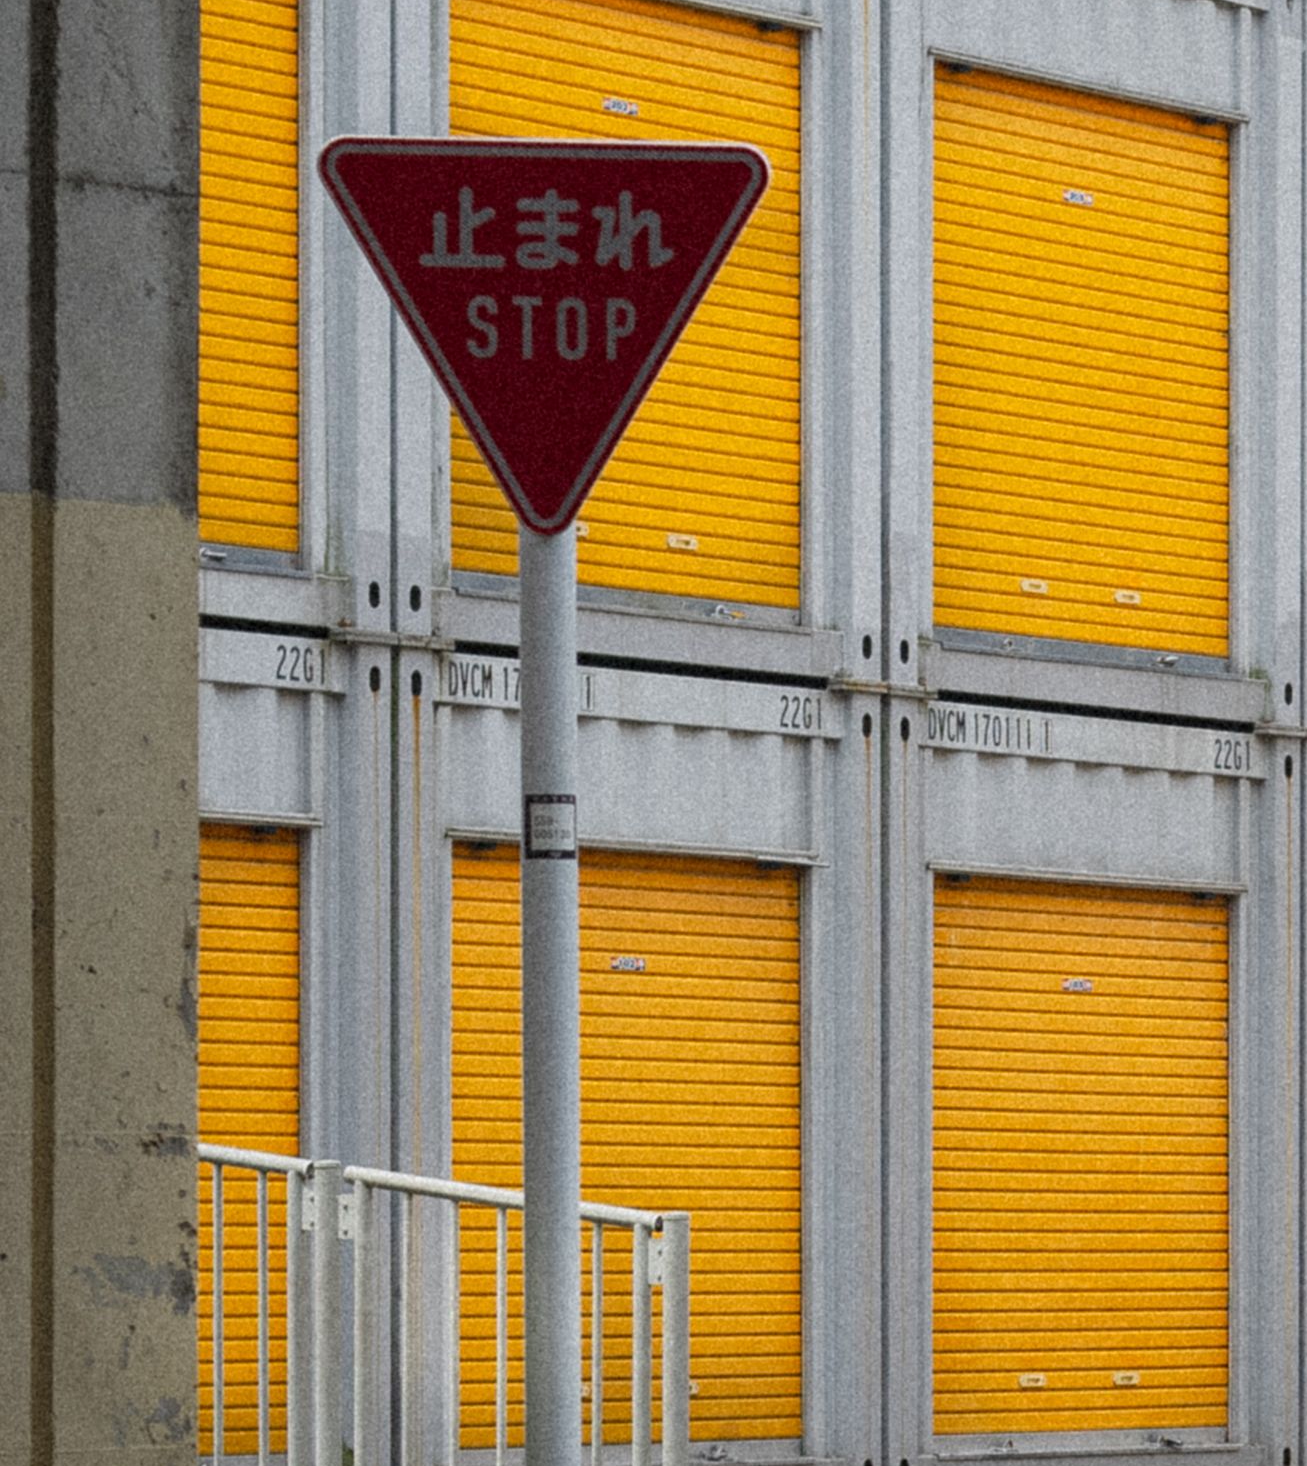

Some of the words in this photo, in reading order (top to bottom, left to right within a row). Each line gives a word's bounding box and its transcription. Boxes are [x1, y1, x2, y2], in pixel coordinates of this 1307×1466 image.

[419, 186, 675, 270] 止まれ
[467, 295, 637, 361] STOP
[275, 645, 326, 685] 22G1
[448, 660, 493, 700] DVCM
[780, 695, 822, 730] 22G1
[928, 707, 966, 743] DVCM
[973, 713, 1031, 750] 170111
[1214, 738, 1251, 773] 22G1
